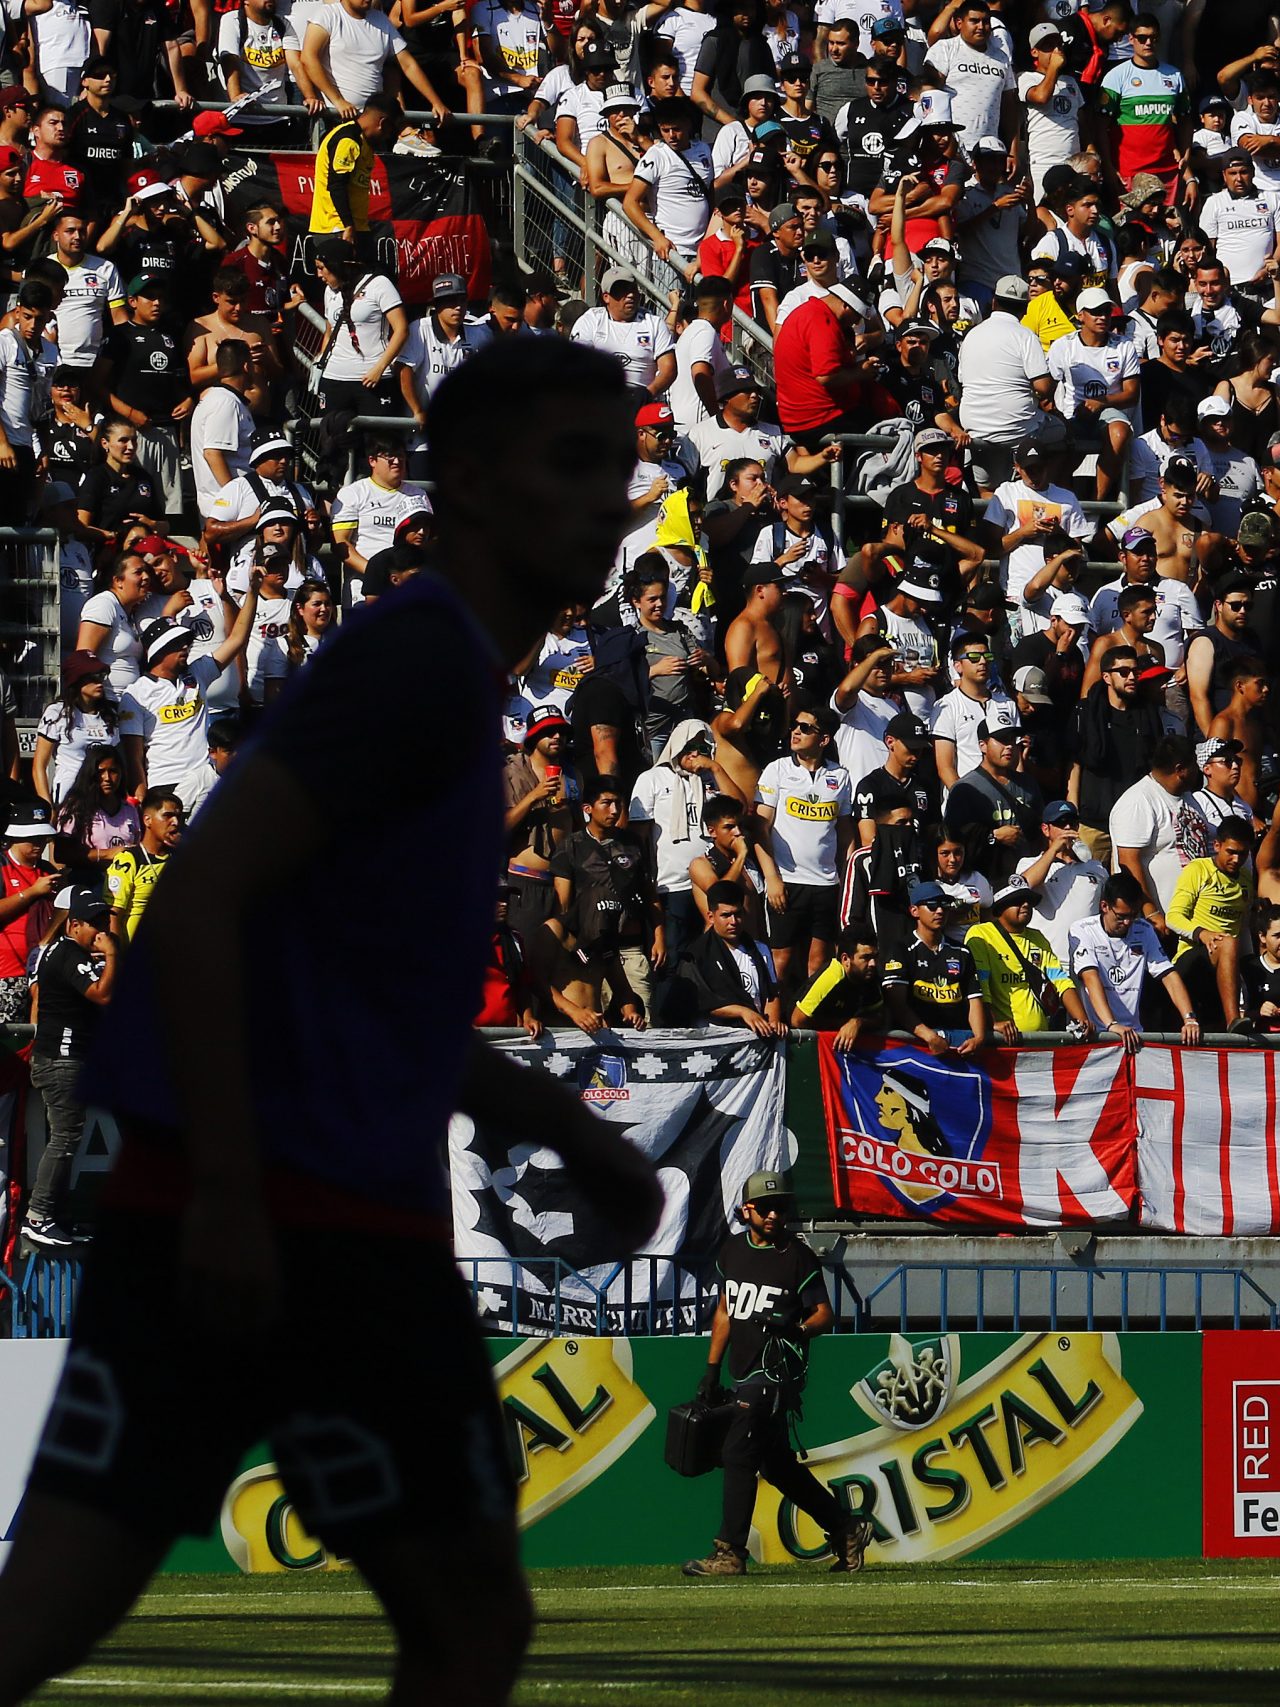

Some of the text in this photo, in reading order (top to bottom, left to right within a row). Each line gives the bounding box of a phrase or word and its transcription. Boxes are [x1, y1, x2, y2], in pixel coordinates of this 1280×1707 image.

[581, 1090, 628, 1100] OLO-COLO
[725, 1279, 783, 1320] CDF
[777, 1358, 1105, 1563] CRISTAL
[1244, 1396, 1269, 1479] RED
